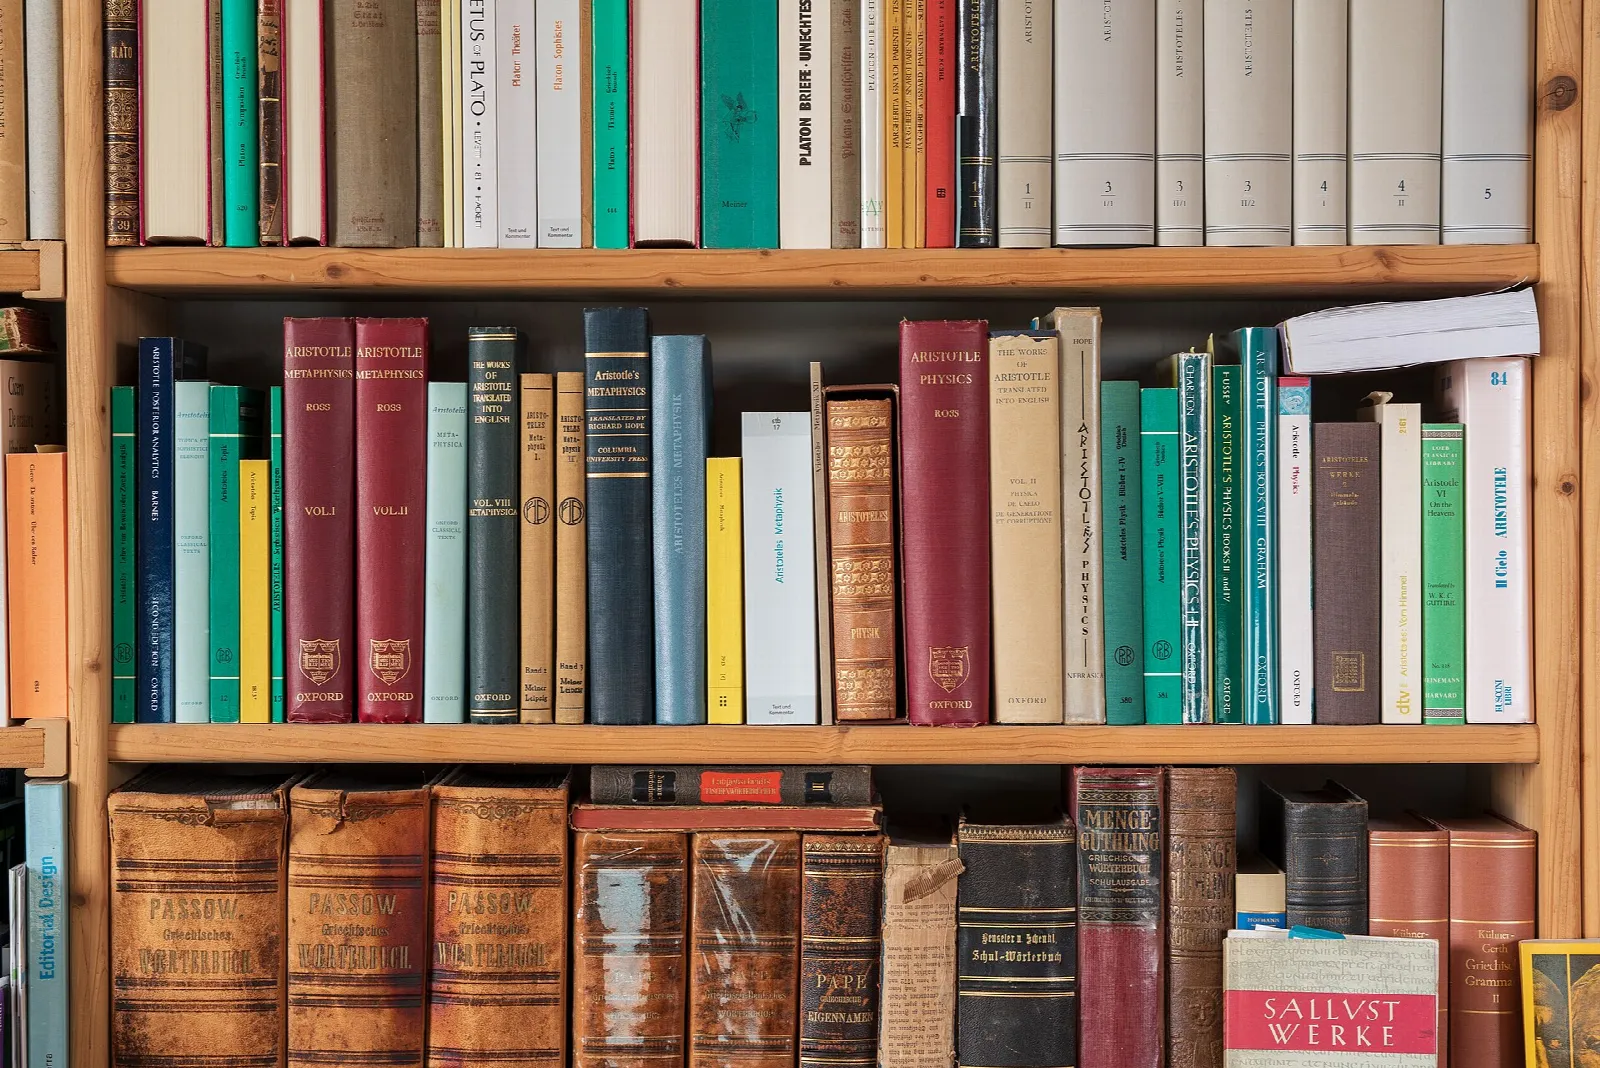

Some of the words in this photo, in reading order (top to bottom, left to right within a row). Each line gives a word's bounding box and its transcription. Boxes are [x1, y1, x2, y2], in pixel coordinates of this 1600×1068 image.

[512, 25, 520, 56] Theätet
[554, 21, 563, 59] Sophistes
[799, 0, 812, 61] UNECHTES
[112, 46, 132, 59] PLATO
[474, 44, 482, 56] OF
[1244, 9, 1252, 78] ARISTOTELES
[512, 62, 520, 86] Platon
[554, 64, 562, 90] Platon
[470, 60, 485, 116] PLATO
[800, 70, 812, 110] BRIEFE
[238, 87, 248, 126] Symposion
[800, 118, 812, 166] PLATON
[238, 144, 246, 167] Platon
[474, 172, 482, 180] 81
[1176, 180, 1183, 192] 3
[1244, 180, 1252, 192] 3
[1320, 180, 1327, 192] 4
[1398, 180, 1405, 192] 4
[1026, 183, 1031, 194] 1
[1104, 181, 1112, 193] 3
[1484, 188, 1491, 200] 5
[117, 220, 130, 230] 39
[286, 346, 351, 357] ARISTOTLE
[356, 346, 422, 358] ARISTOTLE
[911, 352, 981, 363] ARISTOTLE
[284, 368, 353, 379] METAPHYSICS
[356, 369, 424, 380] METAPHYSICS
[594, 370, 640, 380] Aristotle's
[920, 374, 972, 385] PHYSICS
[994, 372, 1050, 381] ARISTOTLE
[1256, 350, 1266, 409] ARISTOTLE
[1491, 371, 1507, 386] 84
[473, 382, 512, 391] ARISTOTLE
[588, 387, 646, 396] METAPHYSICS
[1186, 365, 1195, 416] CHARLTON
[1222, 371, 1230, 405] HUSSEY
[306, 403, 330, 411] ROSS
[473, 394, 512, 402] TRANSLATED
[935, 409, 959, 418] ROSS
[672, 393, 682, 468] METAPHYSIK
[1398, 418, 1407, 434] 2161
[1222, 414, 1231, 482] ARISTOTLE'S
[1256, 421, 1266, 468] PHYSICS
[1292, 424, 1300, 459] Aristotle
[1184, 432, 1199, 528] ARISTOTLE'S
[1256, 471, 1266, 504] BOOK
[1291, 466, 1300, 494] Physics
[1423, 478, 1458, 487] Aristotle
[305, 506, 336, 516] VOL.I
[373, 506, 408, 515] VOL.II
[774, 488, 785, 535] Metaphysik
[1222, 486, 1231, 530] PHYSICS
[1494, 467, 1507, 538] ARISTOTELE
[673, 476, 683, 554] ARISTOTELES
[838, 510, 888, 522] ARISTOTELES
[1119, 504, 1128, 526] Physik
[1256, 506, 1266, 527] VIII
[1222, 533, 1230, 564] BOOKS
[774, 540, 784, 584] Aristoteles
[1184, 538, 1199, 604] PHYSICS
[1256, 538, 1266, 589] GRAHAM
[1495, 550, 1507, 577] Cielo
[1222, 577, 1230, 591] and
[1399, 575, 1408, 608] Himmel
[851, 628, 880, 639] PHYSIK
[1257, 655, 1267, 703] OXFORD
[1292, 669, 1301, 707] OXFORD
[296, 692, 344, 702] OXFORD
[368, 692, 414, 702] OXFORD
[929, 700, 972, 709] OXFORD
[1223, 678, 1231, 714] OXFORD
[1395, 690, 1410, 715] dtv
[1495, 679, 1503, 713] RUSCONI
[1086, 810, 1157, 829] MENGE-
[1080, 831, 1158, 851] GÜTHLING
[1089, 862, 1150, 873] WÖRTERBUCH
[38, 856, 57, 908] Design
[150, 898, 243, 920] PASSOW.
[309, 894, 402, 916] PASSOW.
[448, 891, 537, 915] PASSOW.
[1393, 928, 1429, 938] Kühner-
[1478, 929, 1515, 939] Kühner-
[38, 914, 54, 980] Editorial
[972, 950, 1062, 964] Schul-Wörterbuch
[1482, 943, 1508, 953] Gerth
[816, 974, 867, 989] PAPE
[1492, 994, 1499, 1003] II
[807, 1012, 873, 1023] EIGENNAMEN
[1264, 997, 1401, 1022] SALLVST
[1268, 1023, 1394, 1047] WERKE
